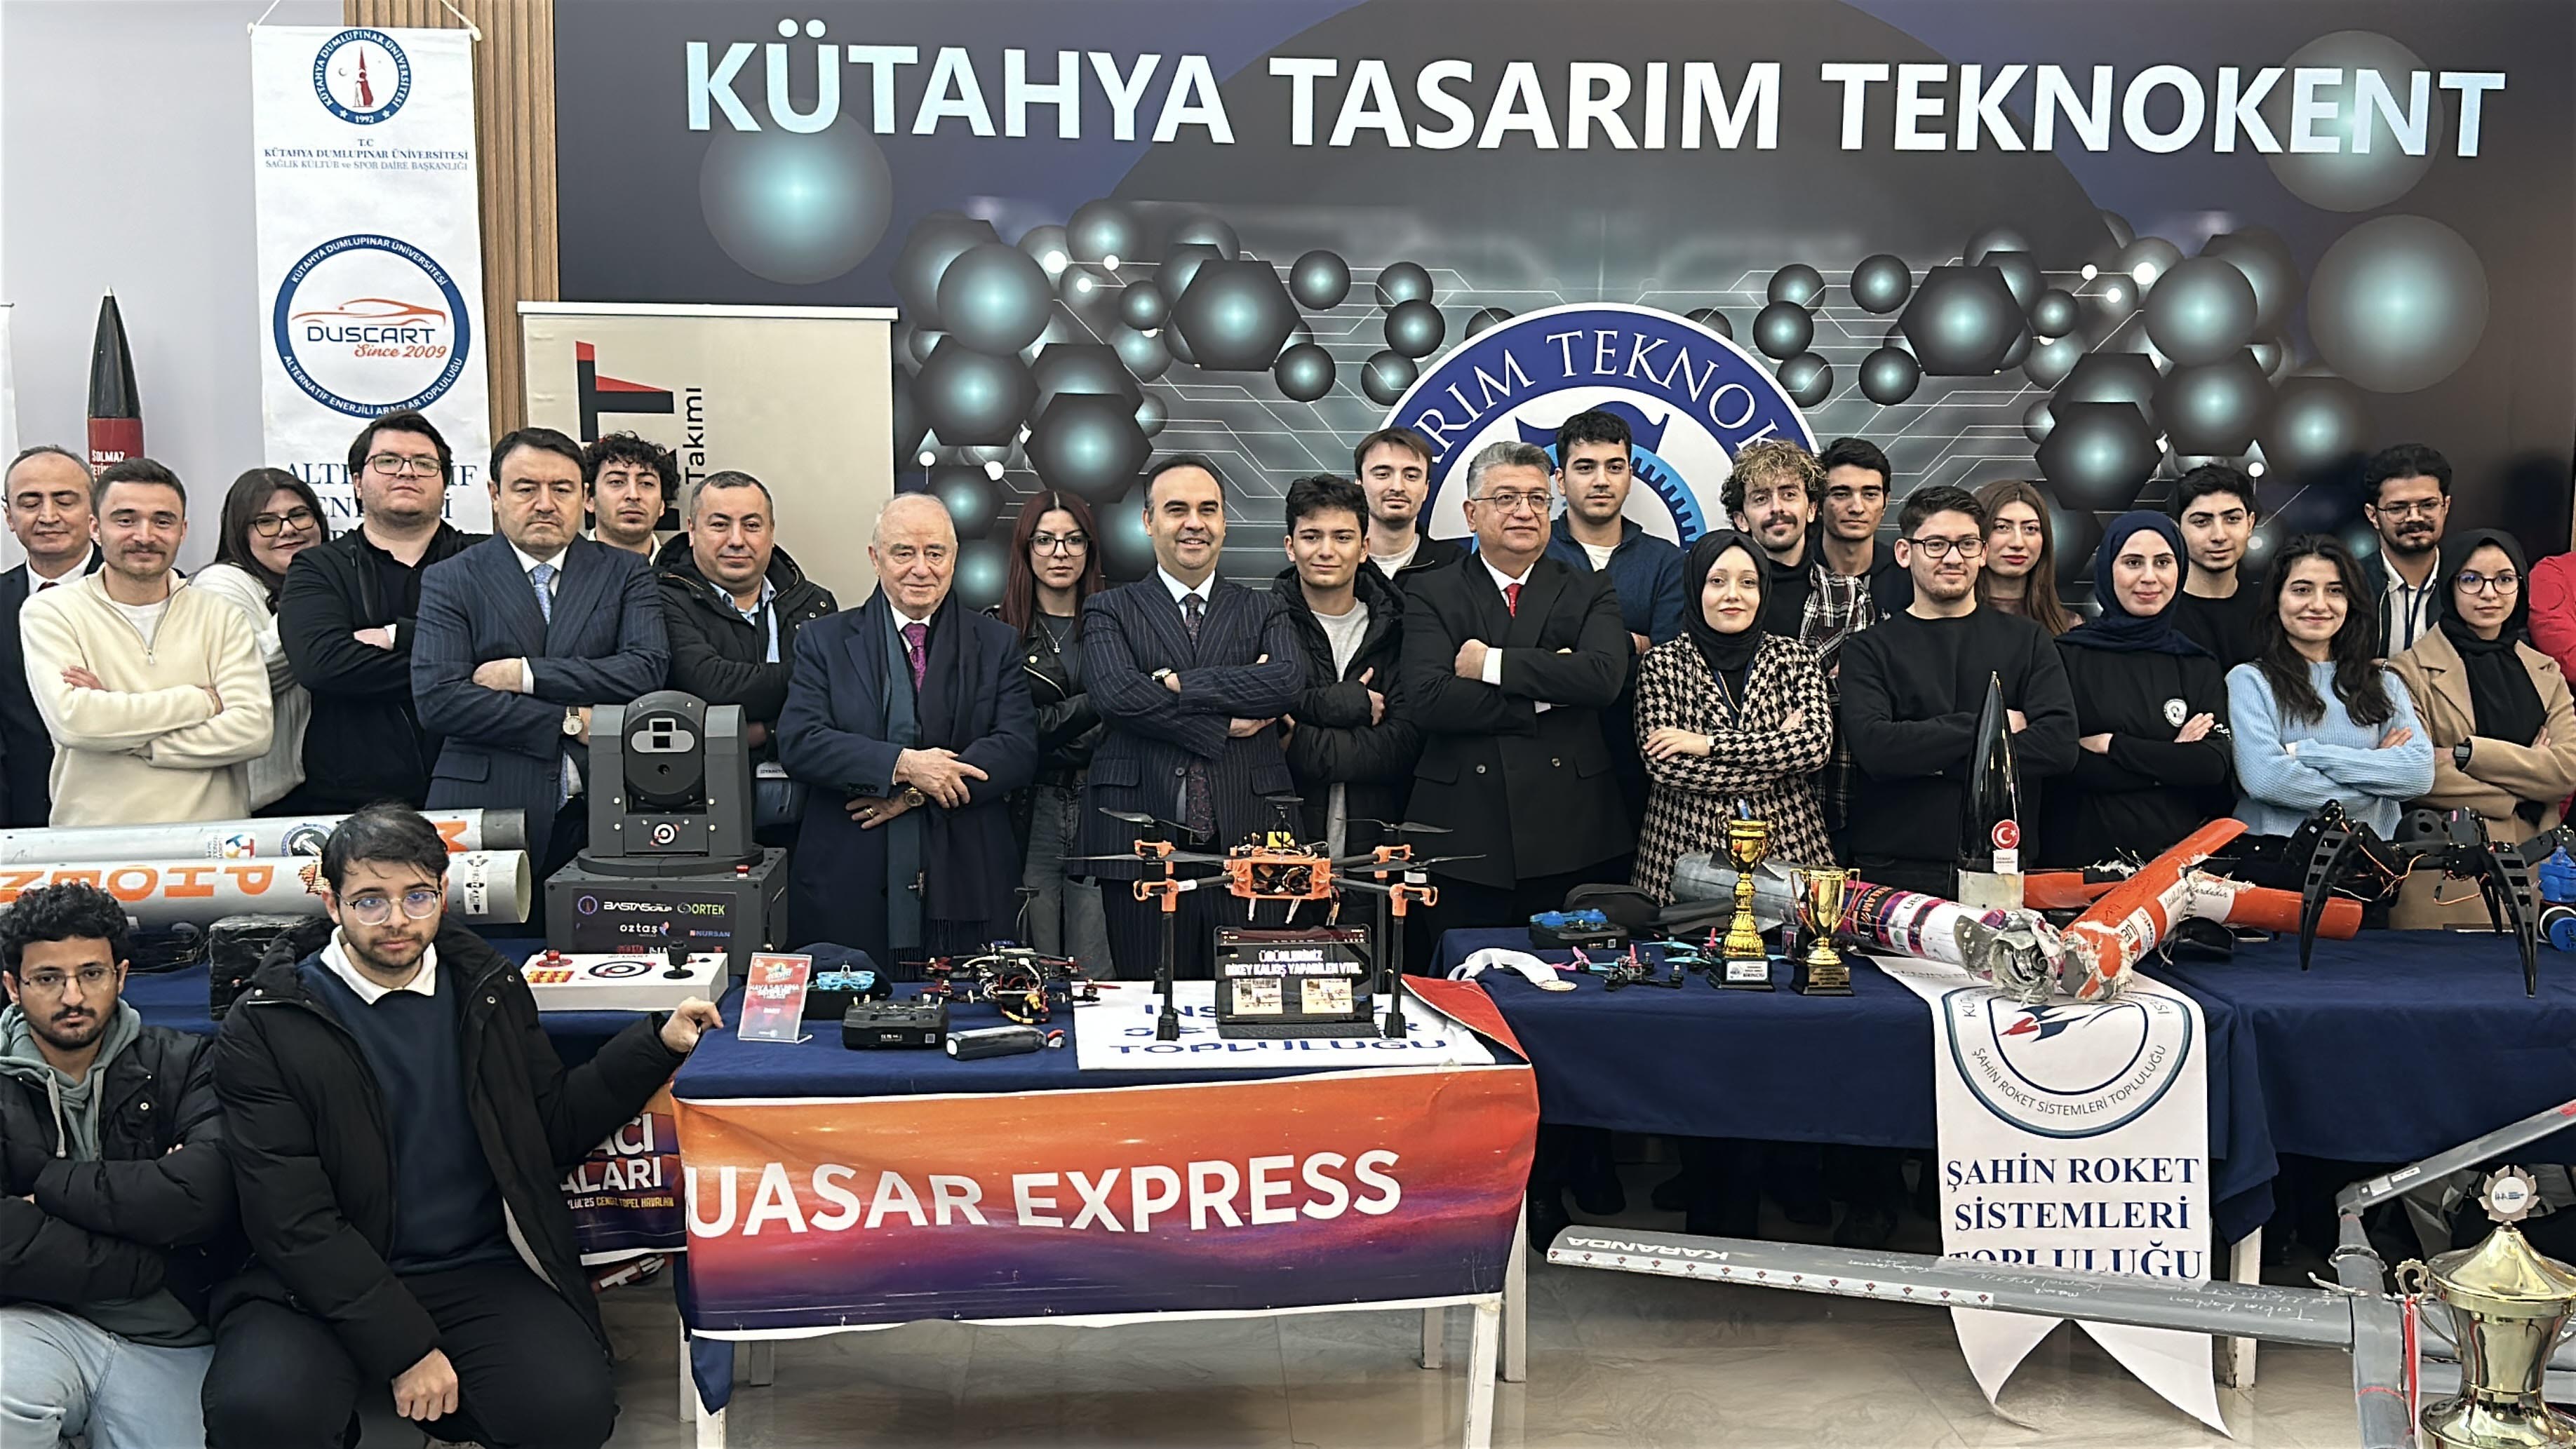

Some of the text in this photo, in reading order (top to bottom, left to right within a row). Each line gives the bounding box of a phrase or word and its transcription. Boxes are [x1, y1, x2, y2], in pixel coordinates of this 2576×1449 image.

[321, 30, 385, 59] DUMLUPINAR
[685, 18, 2507, 157] KÜTAHYA TASARIM TEKNOKENT
[355, 114, 375, 124] 1992
[264, 149, 469, 161] KÜTAHYA DUMLUPINAR ÜNİVERSİTESİ
[353, 161, 379, 170] SPOR
[291, 249, 328, 284] KÜTAHYA
[326, 237, 390, 254] DUMLUPINAR
[307, 326, 436, 344] DUSCART
[354, 344, 447, 358] Since 2009
[283, 355, 329, 400] ALTERNATİF
[420, 358, 463, 403] TOPLULUĞU
[682, 386, 706, 485] Takımı
[692, 903, 725, 916] ORTEK
[1971, 1045, 2166, 1117] ŞAHİN ROKET SİSTEMLERİ TOPLULUĞU
[1946, 1152, 2200, 1192] ŞAHİN ROKET
[685, 1149, 1402, 1240] UASAR EXPRESS
[1954, 1196, 2192, 1232] SİSTEMLERİ
[1566, 1236, 1729, 1261] KARANDA
